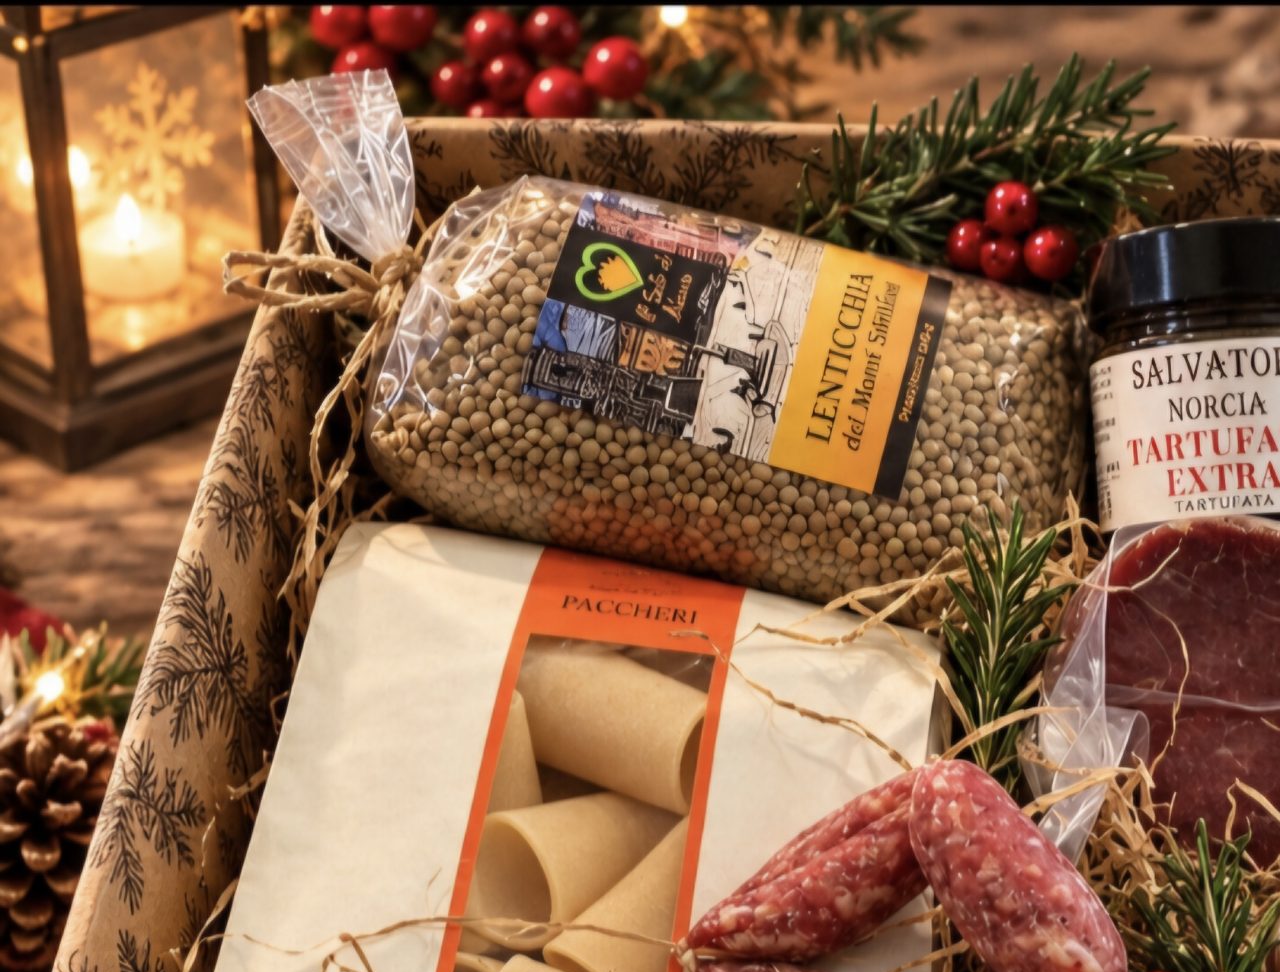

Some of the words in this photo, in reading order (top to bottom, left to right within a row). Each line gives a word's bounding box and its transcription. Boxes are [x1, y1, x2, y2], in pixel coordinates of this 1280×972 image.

[805, 272, 874, 445] LENTICCHIA
[1168, 391, 1268, 423] NORCIA
[1174, 493, 1275, 514] TARTUFATA
[561, 594, 698, 626] PACCHERI
